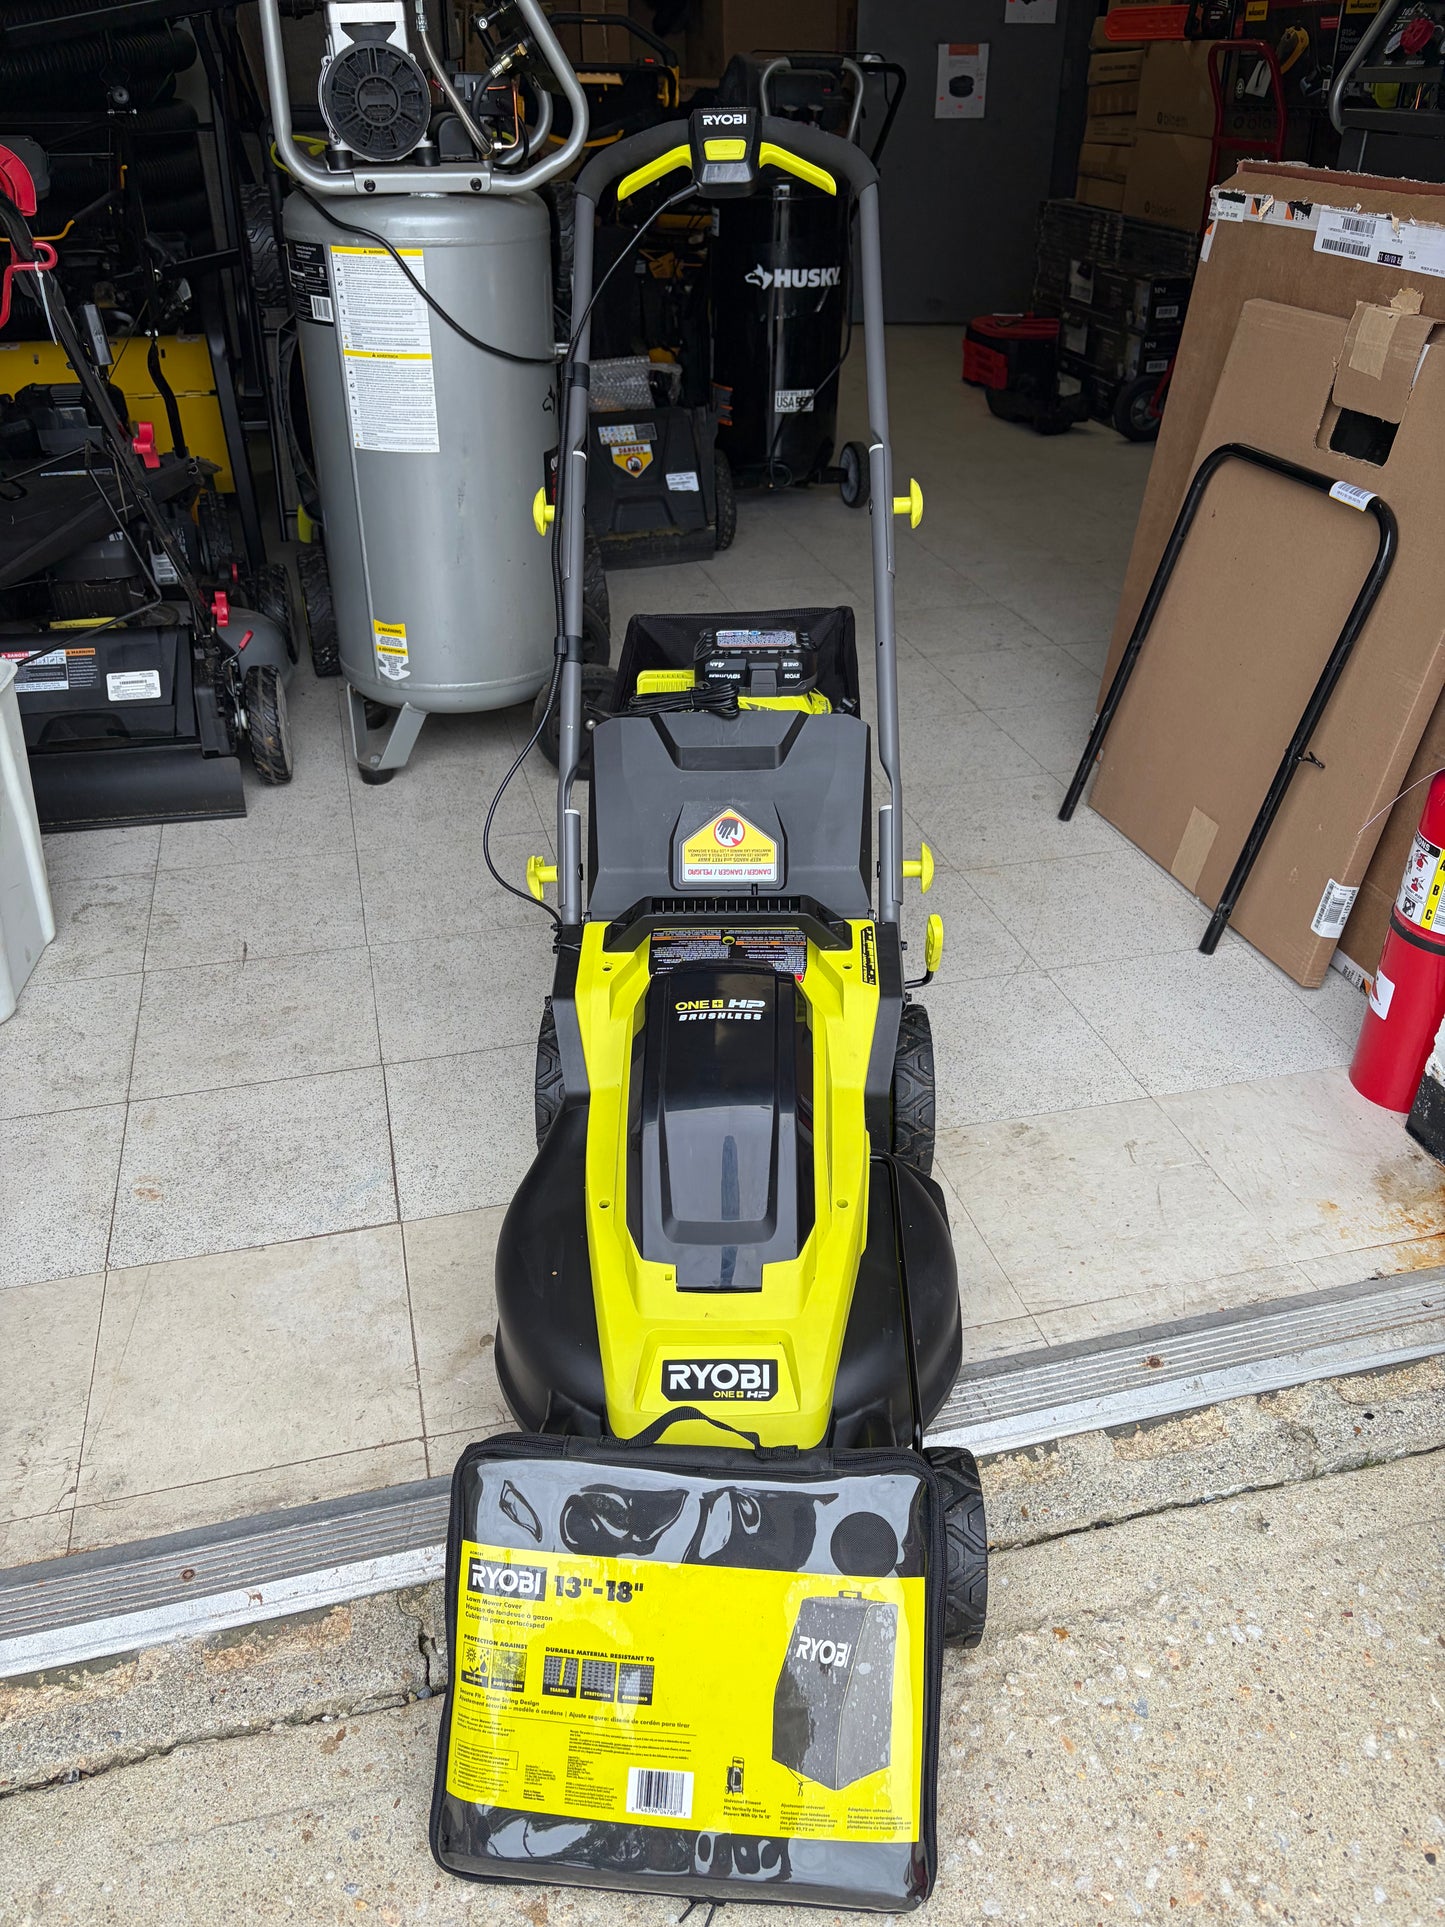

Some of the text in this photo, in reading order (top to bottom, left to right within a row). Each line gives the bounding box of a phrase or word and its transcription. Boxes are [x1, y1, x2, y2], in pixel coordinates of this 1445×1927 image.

[702, 114, 746, 125] RYOBI
[774, 267, 840, 288] HUSKY
[777, 397, 794, 408] USA
[1433, 884, 1439, 895] B
[1426, 910, 1432, 920] C
[728, 999, 765, 1008] HP
[679, 1013, 761, 1021] BRUSHLESS
[668, 1364, 769, 1389] RYOBI
[471, 1564, 541, 1594] RYOBI
[466, 1595, 480, 1603] Lawn
[482, 1599, 502, 1607] Mower
[466, 1603, 485, 1612] Housse
[496, 1610, 525, 1618] tondeuse
[466, 1612, 488, 1622] Cubierta
[507, 1620, 545, 1628] cortacésped
[464, 1634, 498, 1646] PROTECTION
[576, 1650, 608, 1658] MATERIAL
[796, 1636, 852, 1668] RYOBI
[460, 1688, 474, 1697] Secure
[502, 1697, 518, 1705] String
